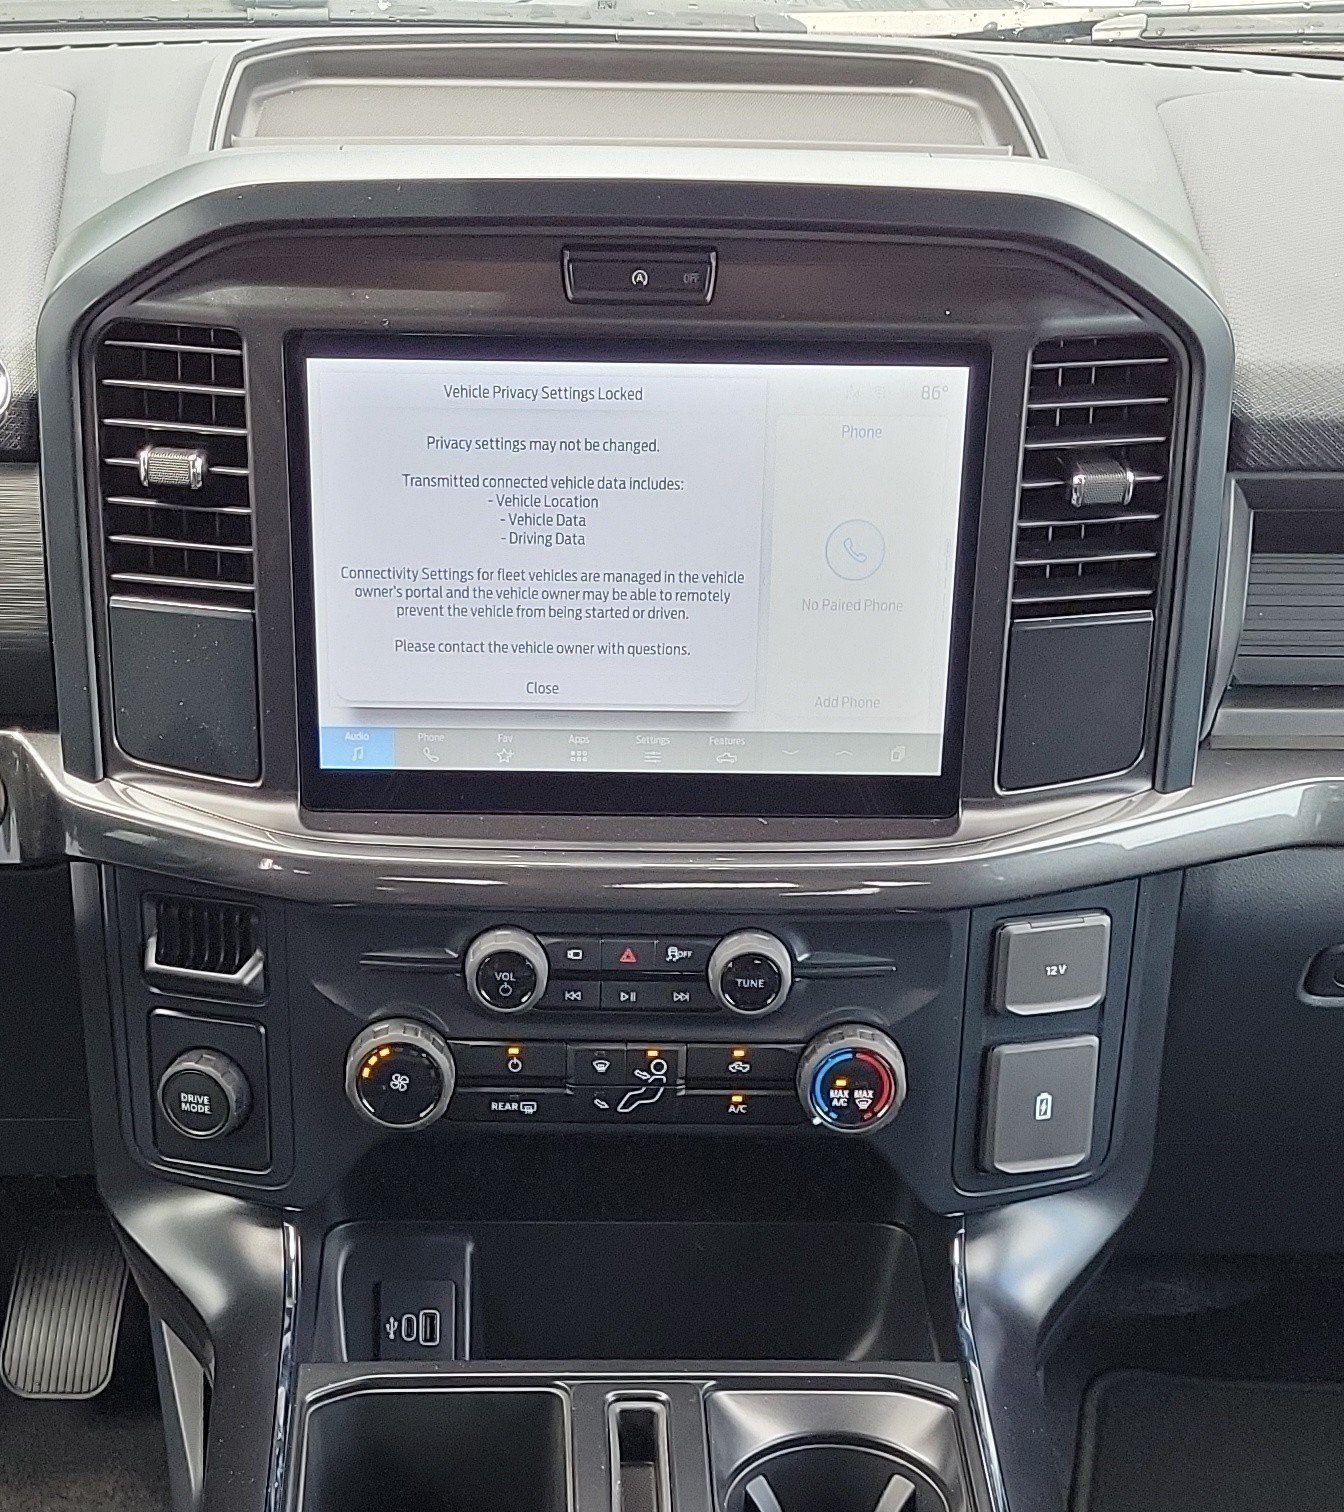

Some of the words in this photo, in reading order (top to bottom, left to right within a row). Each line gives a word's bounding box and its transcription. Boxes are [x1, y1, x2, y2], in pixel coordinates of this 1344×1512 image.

[684, 273, 699, 283] OFF
[443, 384, 490, 399] Vehicle
[492, 385, 539, 402] Privacy
[541, 385, 595, 403] Settings
[598, 386, 643, 401] Locked
[842, 425, 882, 438] Phone
[426, 435, 473, 453] Privacy
[474, 436, 527, 453] settings
[529, 440, 557, 454] may
[559, 438, 582, 452] not
[584, 437, 600, 452] be
[602, 437, 660, 455] changed.
[401, 473, 480, 488] Transmitted
[482, 475, 548, 489] connected
[550, 475, 595, 490] vehicle
[597, 475, 627, 490] data
[629, 476, 684, 491] includes:
[495, 493, 542, 508] Vehicle
[544, 494, 599, 509] Location
[507, 512, 554, 527] Vehicle
[556, 513, 587, 527] Data
[509, 531, 553, 548] Driving
[555, 532, 586, 546] Data
[340, 566, 419, 583] Connectivity
[421, 567, 475, 584] Settings
[476, 567, 495, 581] for
[497, 567, 526, 582] fleet
[528, 568, 578, 582] vehicles
[580, 571, 601, 583] are
[603, 569, 662, 586] managed
[664, 570, 676, 584] in
[678, 570, 700, 584] the
[701, 570, 745, 584] vehicle
[354, 585, 403, 598] owner's
[405, 585, 443, 601] portal
[445, 585, 470, 599] and
[472, 585, 494, 600] the
[495, 586, 539, 600] vehicle
[541, 589, 581, 601] owner
[582, 590, 610, 603] may
[612, 587, 628, 601] be
[629, 587, 657, 602] able
[659, 588, 673, 602] to
[675, 588, 731, 605] remotely
[802, 599, 818, 611] No
[822, 599, 861, 611] Paired
[865, 599, 904, 612] Phone
[396, 604, 445, 619] prevent
[447, 603, 468, 617] the
[470, 604, 514, 618] vehicle
[515, 604, 546, 618] from
[548, 605, 583, 621] being
[584, 605, 630, 619] started
[632, 608, 646, 619] or
[647, 606, 689, 620] driven.
[395, 639, 436, 653] Please
[437, 641, 485, 653] contact
[487, 640, 509, 654] the
[510, 640, 554, 654] vehicle
[556, 644, 595, 655] owner
[597, 641, 625, 655] with
[627, 642, 691, 658] questions.
[526, 681, 560, 695] Close
[815, 695, 838, 708] Add
[842, 696, 880, 708] Phone
[345, 732, 369, 741] Audio
[418, 733, 444, 742] Phone
[498, 734, 513, 743] Fav
[568, 735, 590, 744] Apps
[636, 736, 671, 745] Settings
[709, 737, 745, 745] Features
[677, 950, 692, 958] OFF
[495, 972, 515, 982] VOL
[736, 978, 765, 988] TUNE
[181, 1092, 210, 1104] DRIVE
[830, 1089, 849, 1098] MAX
[854, 1090, 874, 1099] MAX
[491, 1101, 518, 1112] REAR
[831, 1098, 848, 1107] A/C
[181, 1103, 212, 1114] MODE
[728, 1104, 747, 1114] A/C
